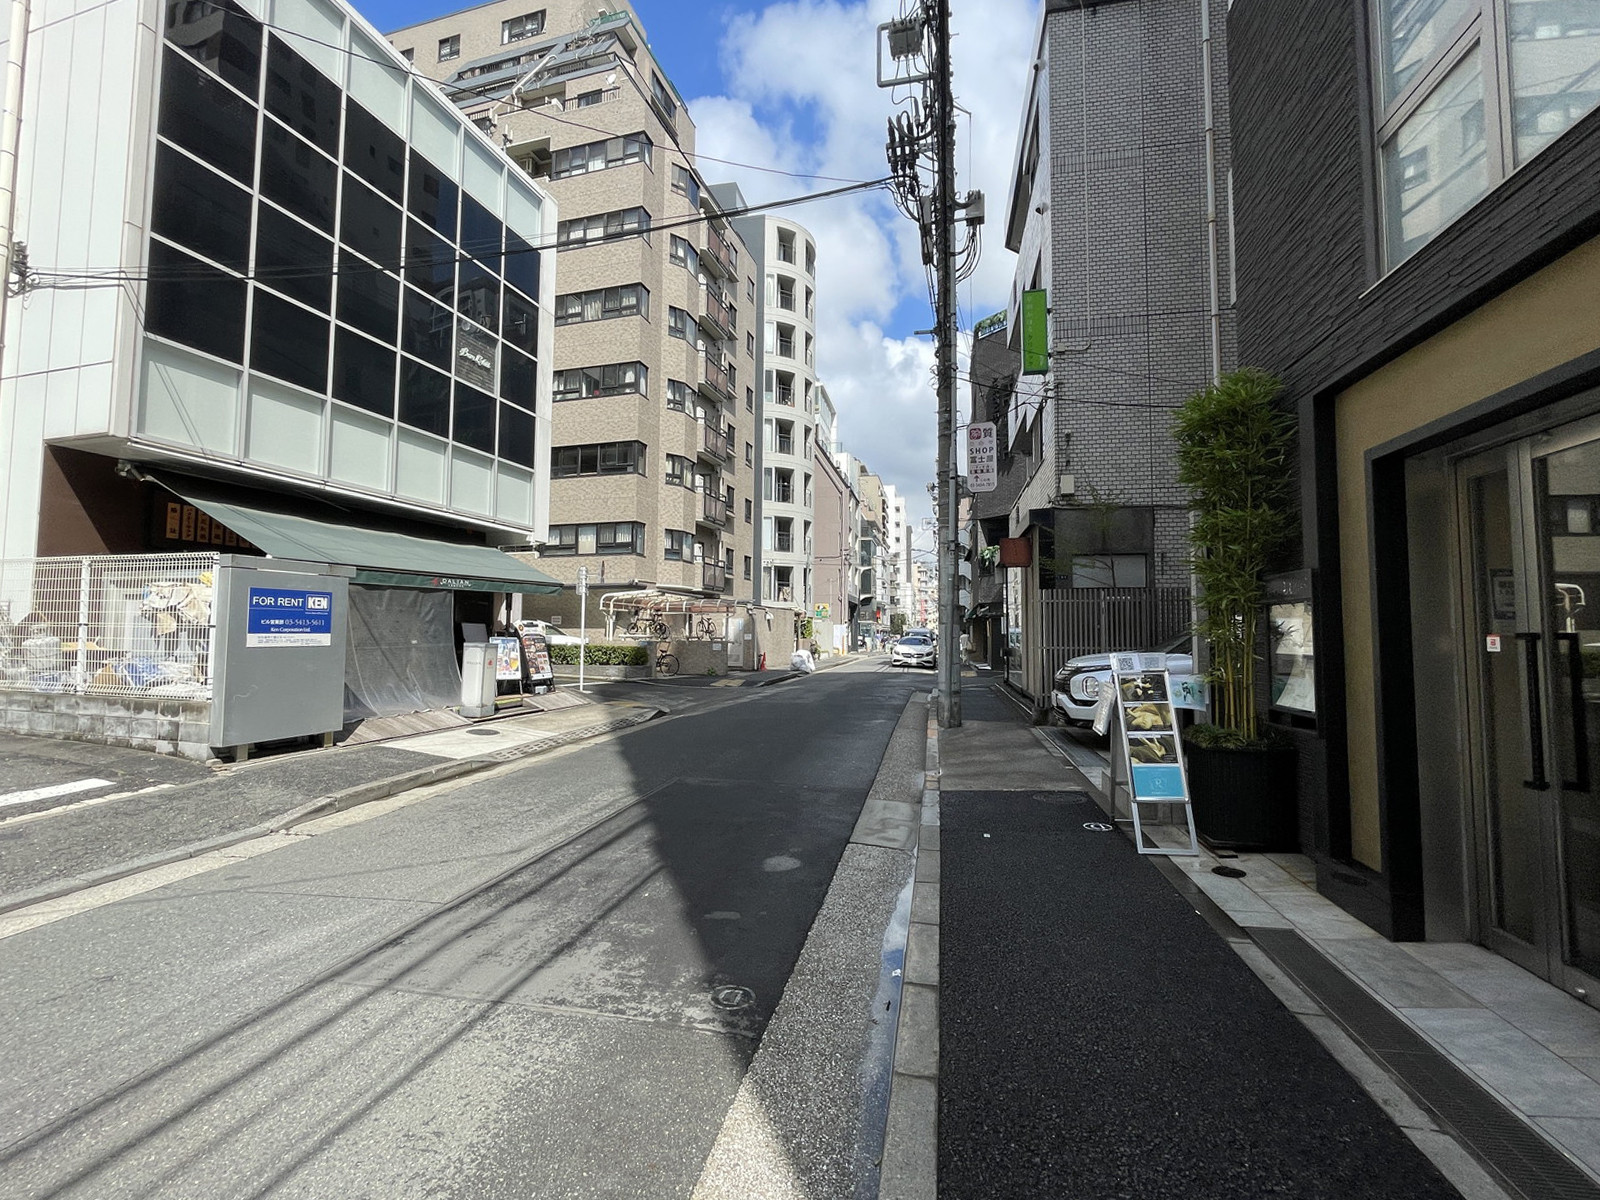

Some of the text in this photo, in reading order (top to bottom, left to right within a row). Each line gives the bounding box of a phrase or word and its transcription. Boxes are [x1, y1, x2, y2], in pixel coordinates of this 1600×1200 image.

[969, 447, 994, 455] SHOP
[252, 596, 304, 607] FOR RENT
[308, 597, 328, 609] KEN
